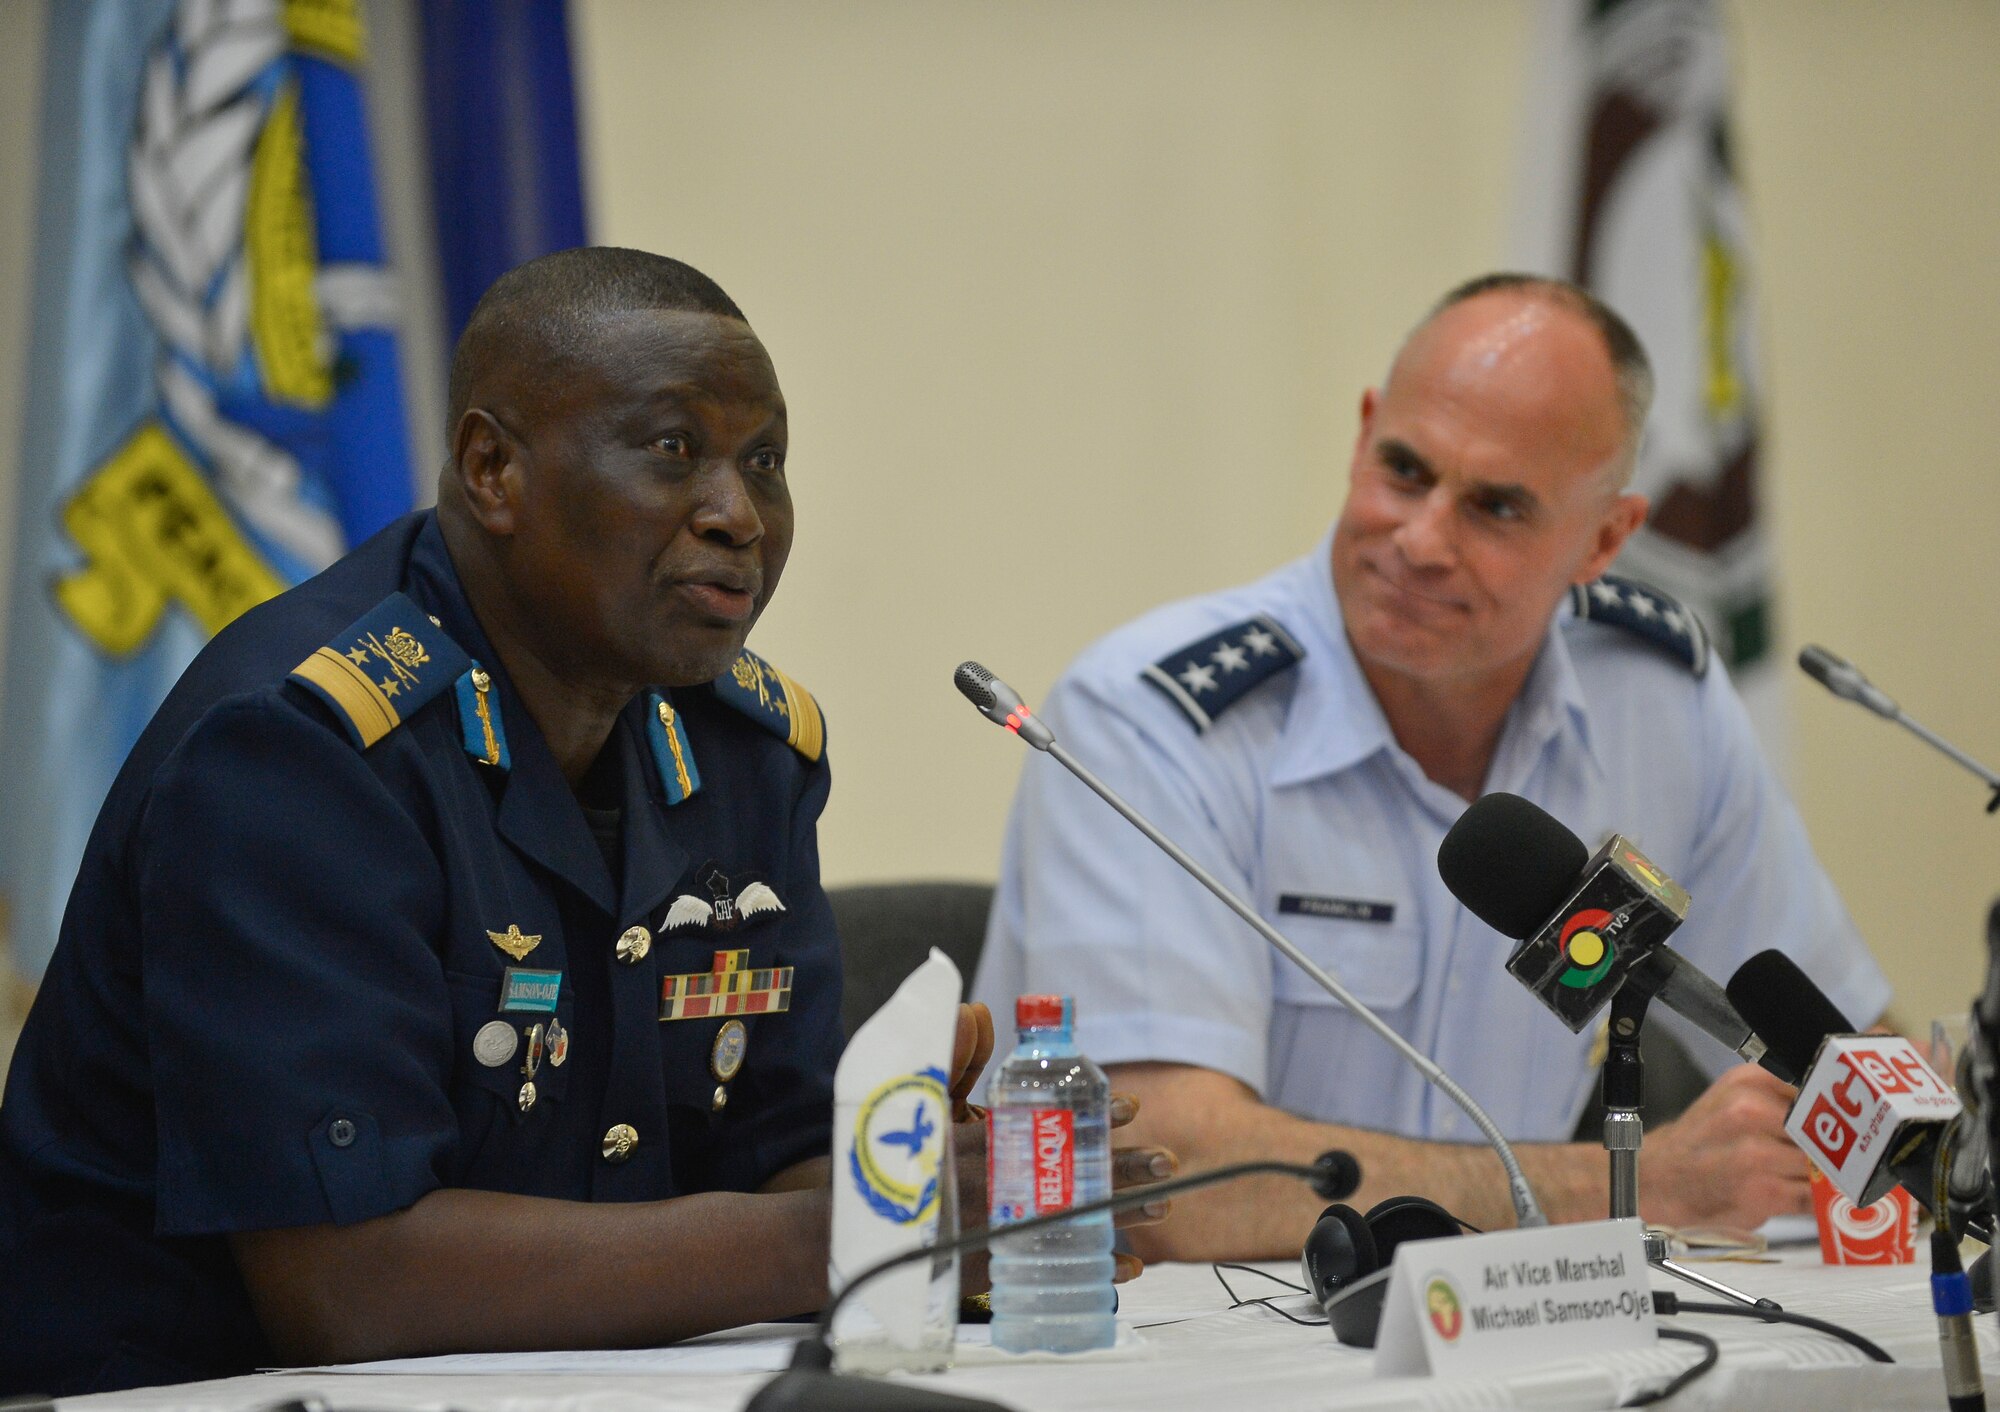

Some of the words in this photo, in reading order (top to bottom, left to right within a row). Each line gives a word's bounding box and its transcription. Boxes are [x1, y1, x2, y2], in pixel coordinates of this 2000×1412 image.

[1606, 912, 1630, 935] TV3
[1872, 1101, 1892, 1136] ghana
[1484, 1266, 1508, 1290] Air
[1511, 1260, 1551, 1287] Vice
[1555, 1252, 1626, 1284] Marshal
[1471, 1301, 1540, 1332] Michael
[1545, 1290, 1650, 1323] Samson-Oje
